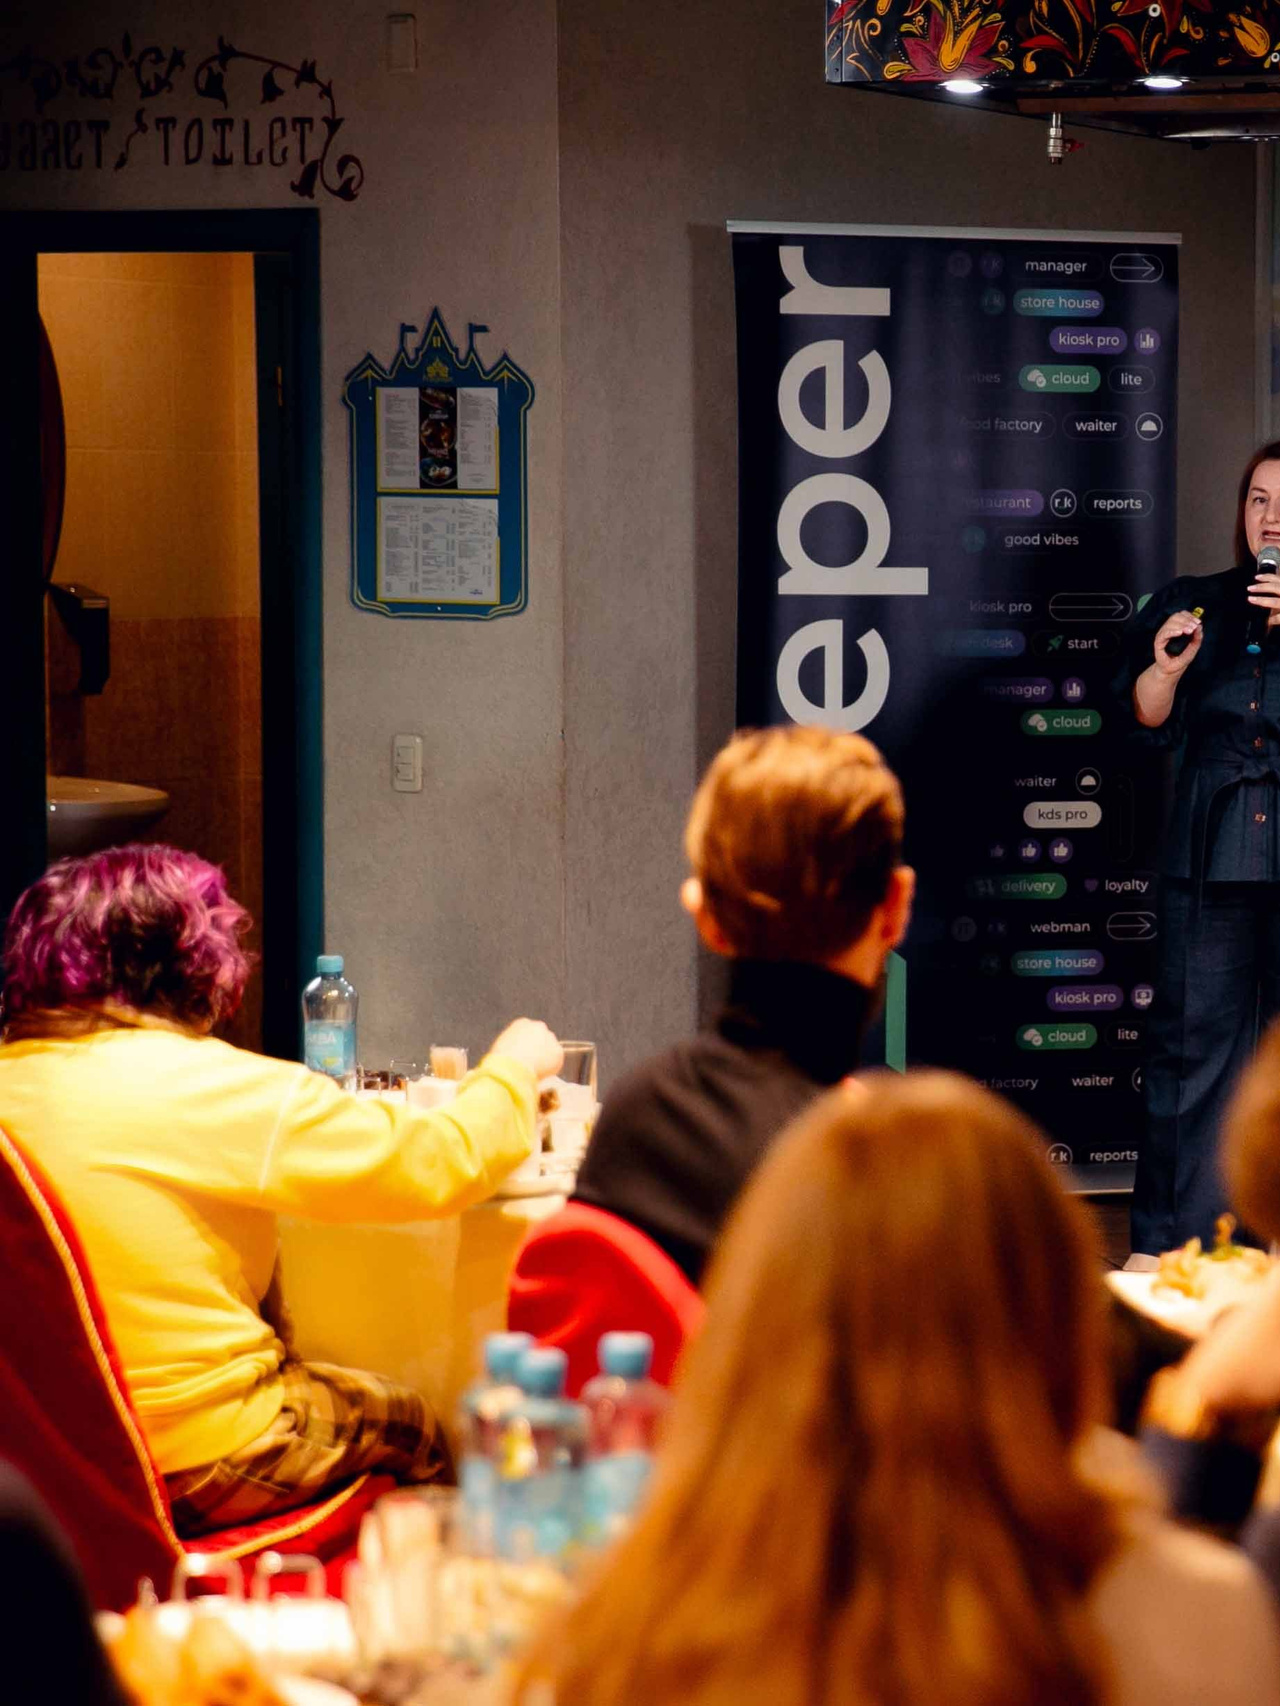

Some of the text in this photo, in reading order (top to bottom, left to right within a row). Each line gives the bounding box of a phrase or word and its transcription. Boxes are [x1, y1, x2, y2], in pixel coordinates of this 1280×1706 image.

[1025, 261, 1088, 275] manager
[1021, 296, 1100, 309] store house
[1058, 332, 1121, 349] kiosk pro
[1051, 371, 1090, 385] cloud
[1121, 373, 1143, 386] lite
[994, 418, 1043, 434] factory
[1075, 420, 1118, 432] waiter
[1093, 498, 1143, 512] reports
[1004, 533, 1080, 548] good vibes
[970, 600, 1033, 615] kiosk pro
[1067, 638, 1099, 649] start
[983, 683, 1047, 699] manager
[1052, 715, 1091, 728] cloud
[1013, 775, 1058, 788] waiter
[1037, 808, 1088, 823] kds pro
[1000, 879, 1057, 895] delivery
[1105, 878, 1149, 894] loyalty
[1030, 921, 1091, 933] webman
[1017, 956, 1097, 969] store house
[1055, 991, 1117, 1006] kiosk pro
[1047, 1029, 1086, 1042] cloud
[1117, 1028, 1139, 1040] lite
[991, 1078, 1039, 1091] factory
[1071, 1076, 1114, 1087] waiter
[1089, 1150, 1139, 1163] reports
